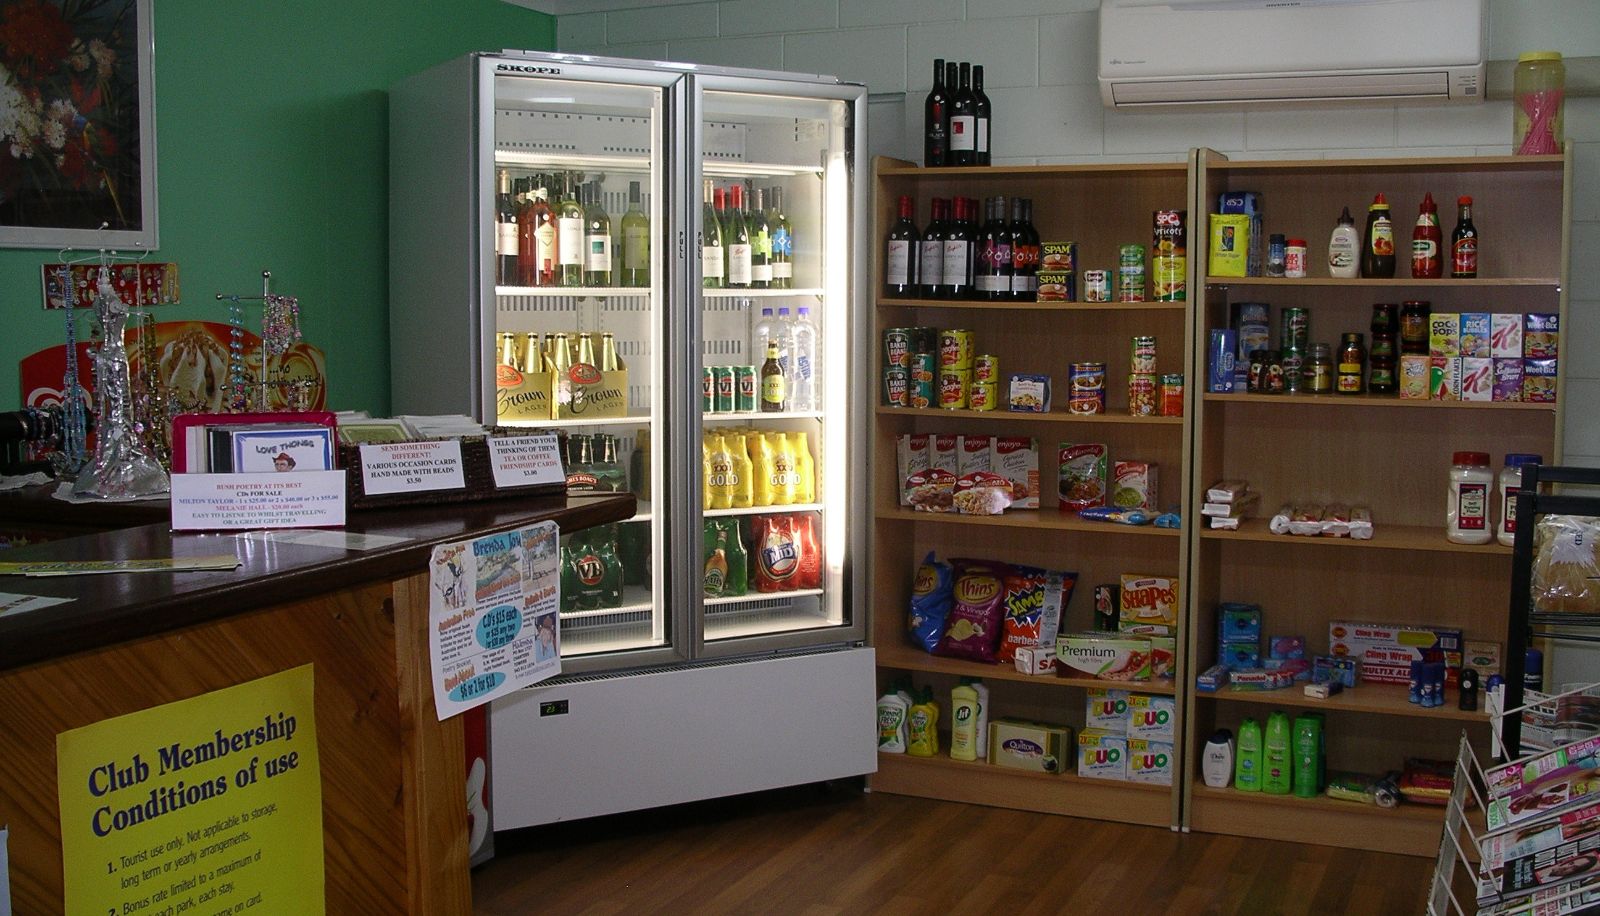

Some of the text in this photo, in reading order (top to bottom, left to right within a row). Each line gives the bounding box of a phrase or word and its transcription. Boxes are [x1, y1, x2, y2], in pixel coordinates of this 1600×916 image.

[496, 64, 560, 75] SKOPE
[1156, 213, 1176, 225] SPC
[1044, 244, 1070, 254] SPAM
[1039, 275, 1066, 284] SPAM
[1432, 320, 1457, 329] COCO
[1465, 319, 1484, 328] RICE
[1432, 328, 1457, 337] POPS
[1453, 358, 1461, 395] CORN FLAKES
[496, 388, 546, 416] Crown
[570, 386, 623, 415] Crown
[518, 403, 547, 415] LAGER
[400, 443, 440, 451] SOMETHING
[493, 439, 511, 447] TELL
[516, 438, 539, 446] FRIEND
[256, 444, 278, 455] LOVE
[366, 458, 457, 470] VARIOUS OCCASION CARDS
[503, 454, 517, 462] TEA
[392, 469, 413, 477] MADE
[499, 462, 537, 471] FRIENDSHIP
[708, 473, 739, 486] GOLD
[472, 538, 506, 557] Brenda
[960, 575, 995, 596] Thins
[1007, 590, 1045, 617] SAMB
[505, 605, 518, 622] each
[1062, 645, 1116, 658] Premium
[1365, 650, 1413, 662] Cling Wrap
[1237, 674, 1266, 682] Panadol
[1092, 699, 1128, 717] DUO
[1132, 710, 1170, 727] DUO
[1009, 740, 1035, 752] Quilton
[88, 712, 297, 797] Club Membership
[1084, 748, 1121, 766] DUO
[1131, 753, 1168, 770] DUO
[91, 750, 299, 838] Conditions of use
[107, 862, 118, 875] 1.
[120, 849, 148, 869] Tourist
[150, 845, 164, 858] use
[186, 829, 201, 844] Not
[203, 815, 240, 839] applicable
[241, 812, 250, 823] to
[120, 874, 140, 890] long
[142, 866, 161, 881] term
[163, 861, 173, 873] or
[174, 850, 198, 872] yearly
[123, 848, 262, 915] Bonus rate limited to a maximum of
[198, 887, 217, 904] each
[234, 901, 244, 914] on
